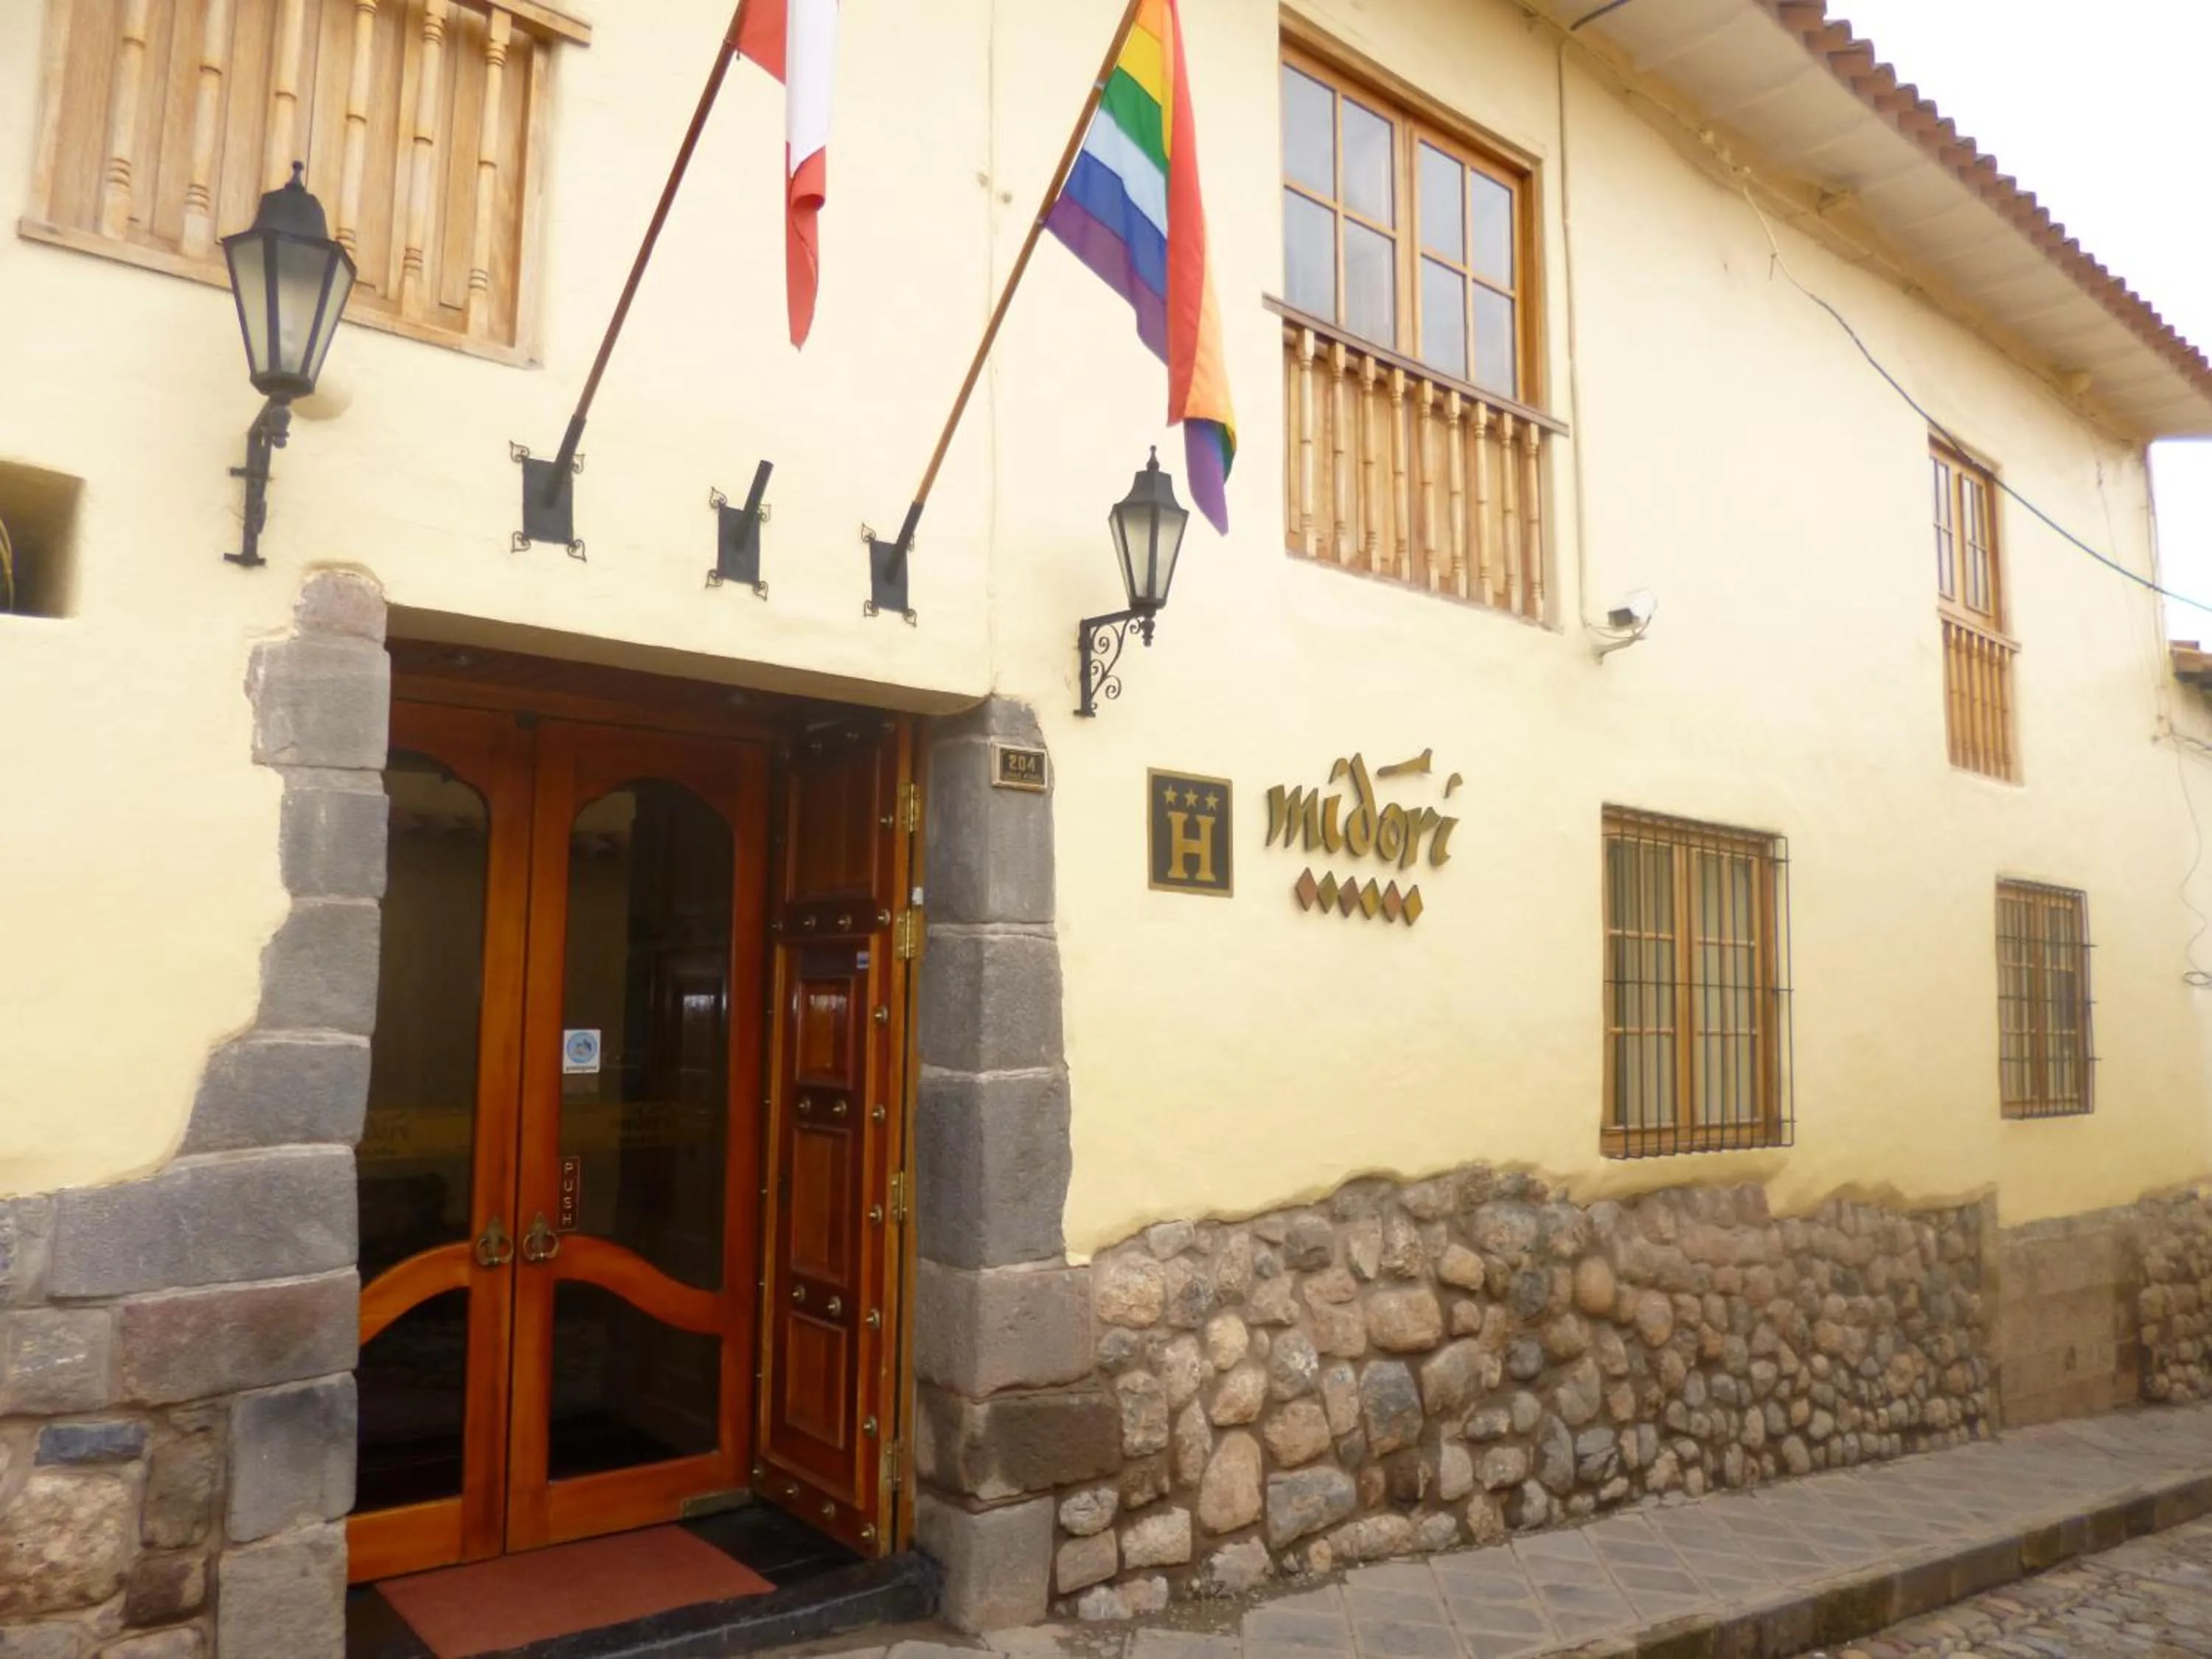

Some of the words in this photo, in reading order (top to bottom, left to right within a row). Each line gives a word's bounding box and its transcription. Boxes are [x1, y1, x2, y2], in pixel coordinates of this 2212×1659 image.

[1009, 754, 1036, 772] 204
[1167, 812, 1216, 882] H
[563, 1162, 574, 1226] PUSH
